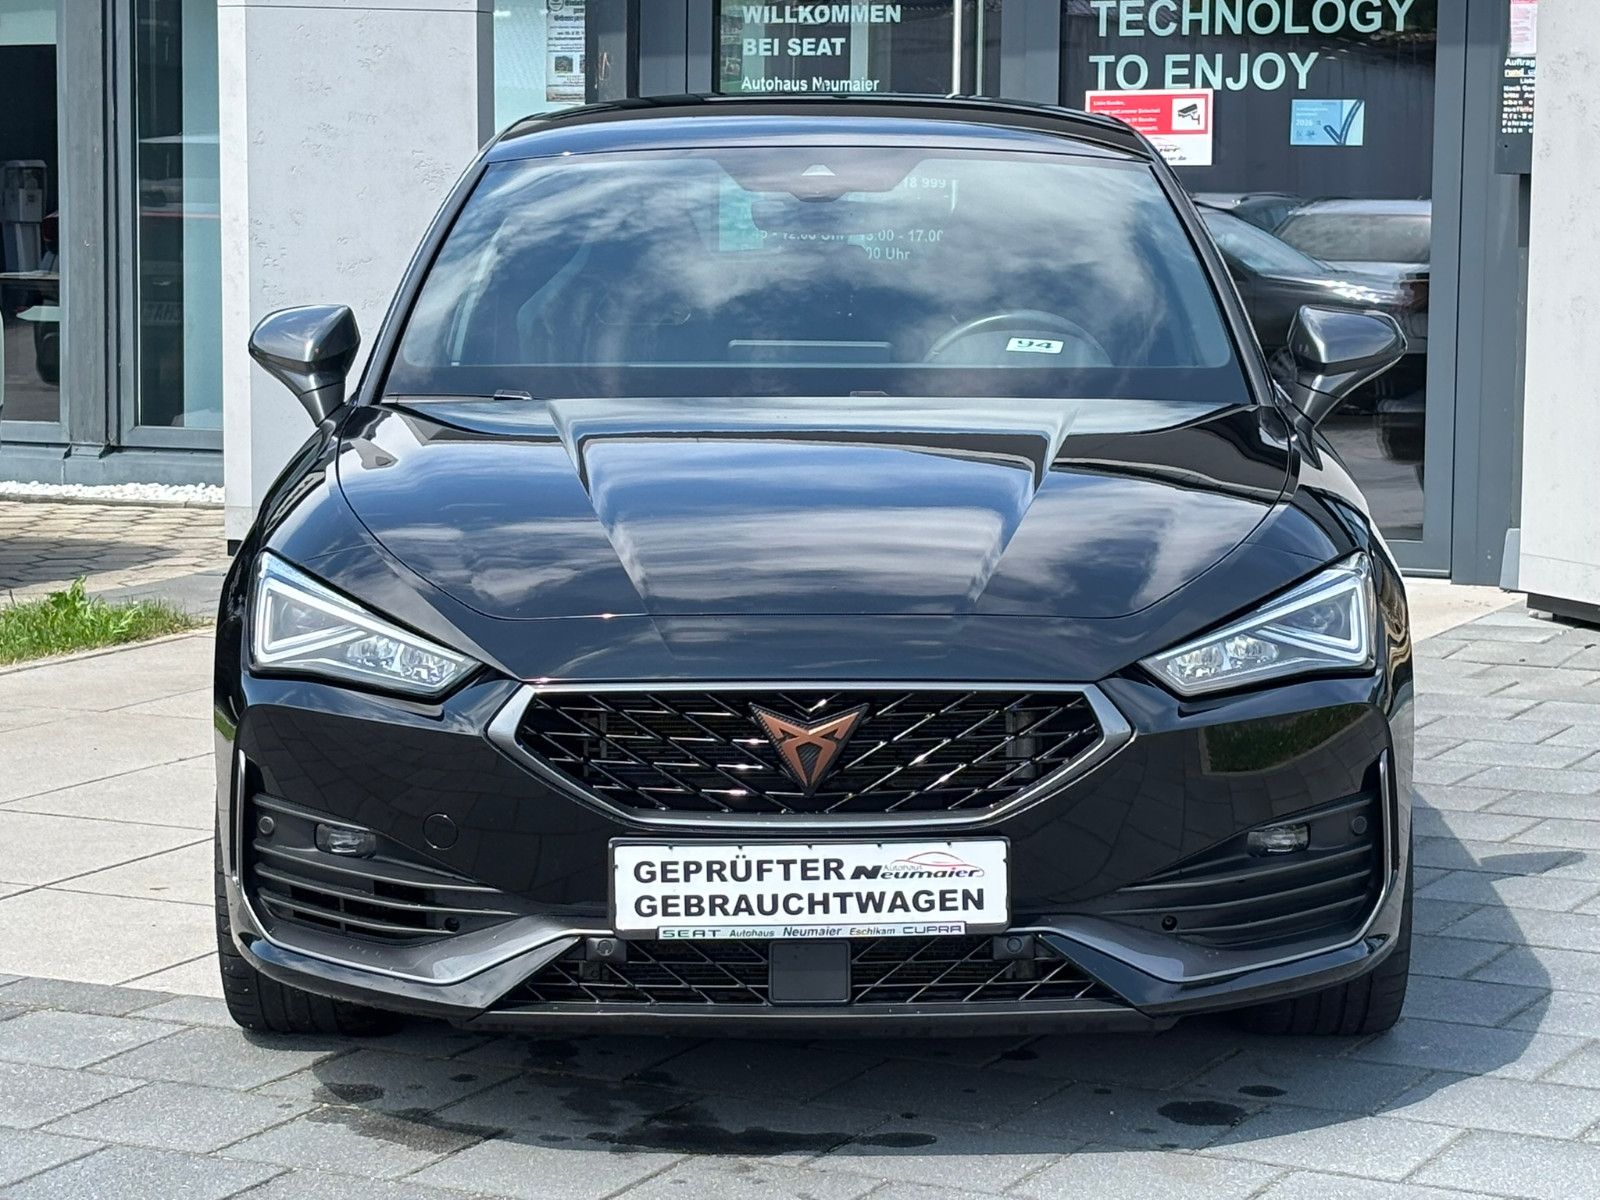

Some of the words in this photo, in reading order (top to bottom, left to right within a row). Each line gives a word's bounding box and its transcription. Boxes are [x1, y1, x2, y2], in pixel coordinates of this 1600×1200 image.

[743, 5, 902, 24] WILLKOMMEN
[1090, 0, 1415, 37] TECHNOLOGY
[743, 38, 780, 57] BEI
[787, 38, 846, 57] SEAT
[1089, 54, 1149, 91] TO
[1164, 52, 1319, 91] ENJOY
[741, 76, 808, 92] Autohaus
[812, 77, 880, 92] Neumaier
[885, 246, 910, 259] Uhr
[633, 854, 846, 884] GEPRÜFTER
[850, 864, 982, 880] Neumaier
[634, 888, 985, 918] GEBRAUCHTWAGEN
[662, 929, 721, 938] SEAT
[729, 929, 775, 938] Autohaus
[782, 926, 842, 938] Neumaier
[902, 925, 962, 935] CUPRA
